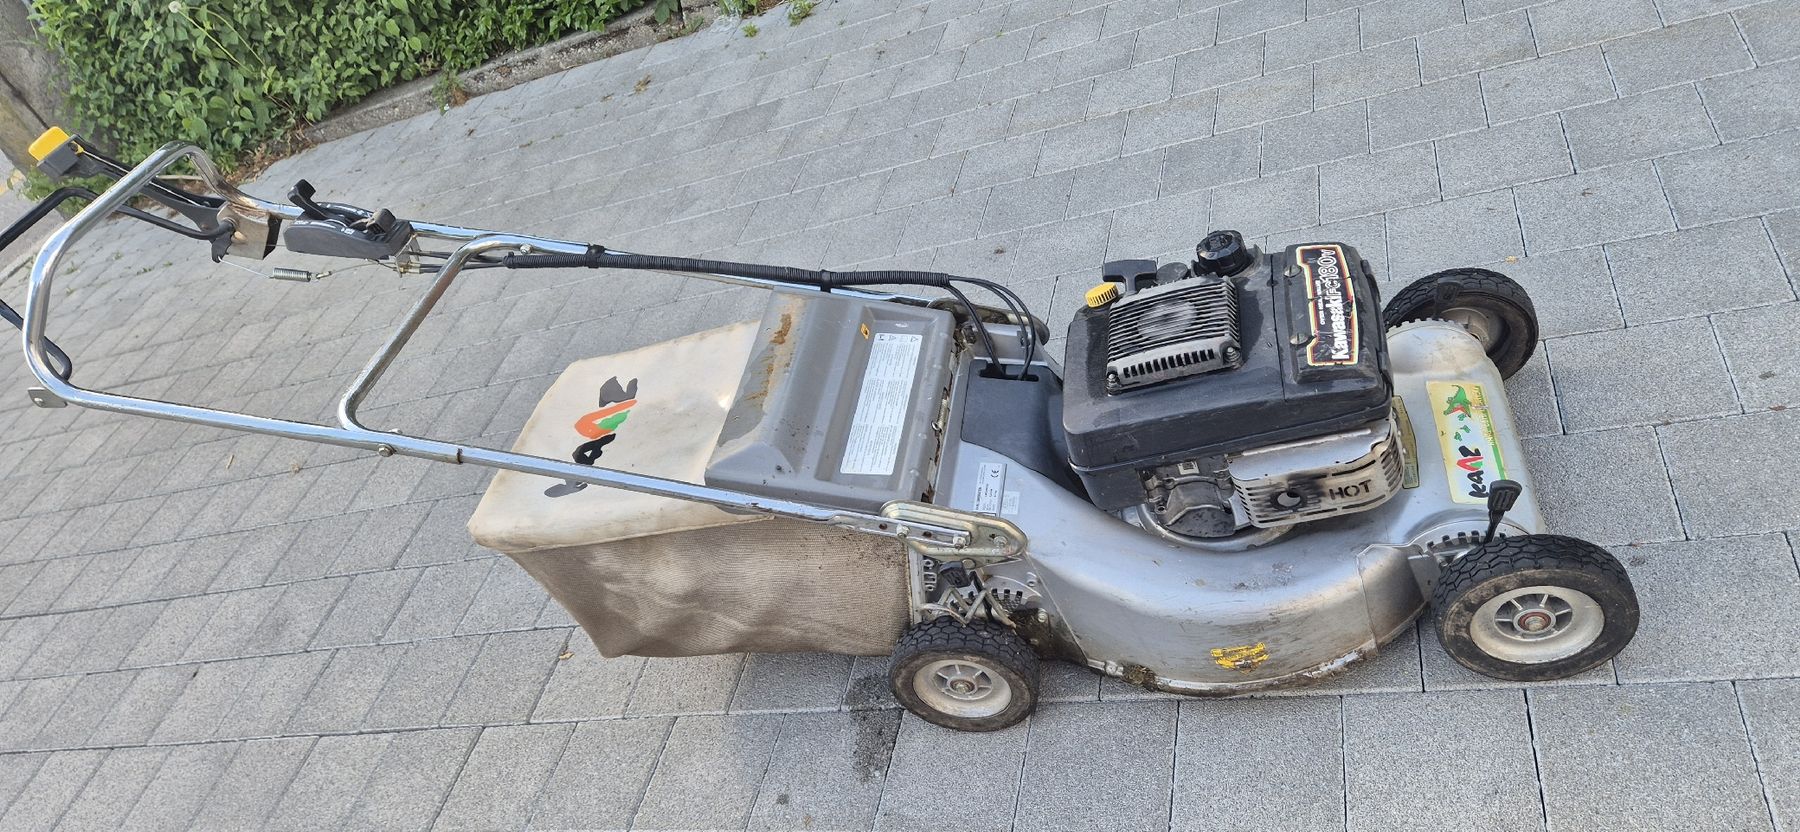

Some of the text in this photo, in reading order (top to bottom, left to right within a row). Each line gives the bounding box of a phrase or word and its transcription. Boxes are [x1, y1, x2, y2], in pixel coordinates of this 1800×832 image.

[1325, 296, 1350, 359] Kawasaki
[1329, 479, 1372, 500] HOT
[1457, 445, 1490, 498] KAAZ
